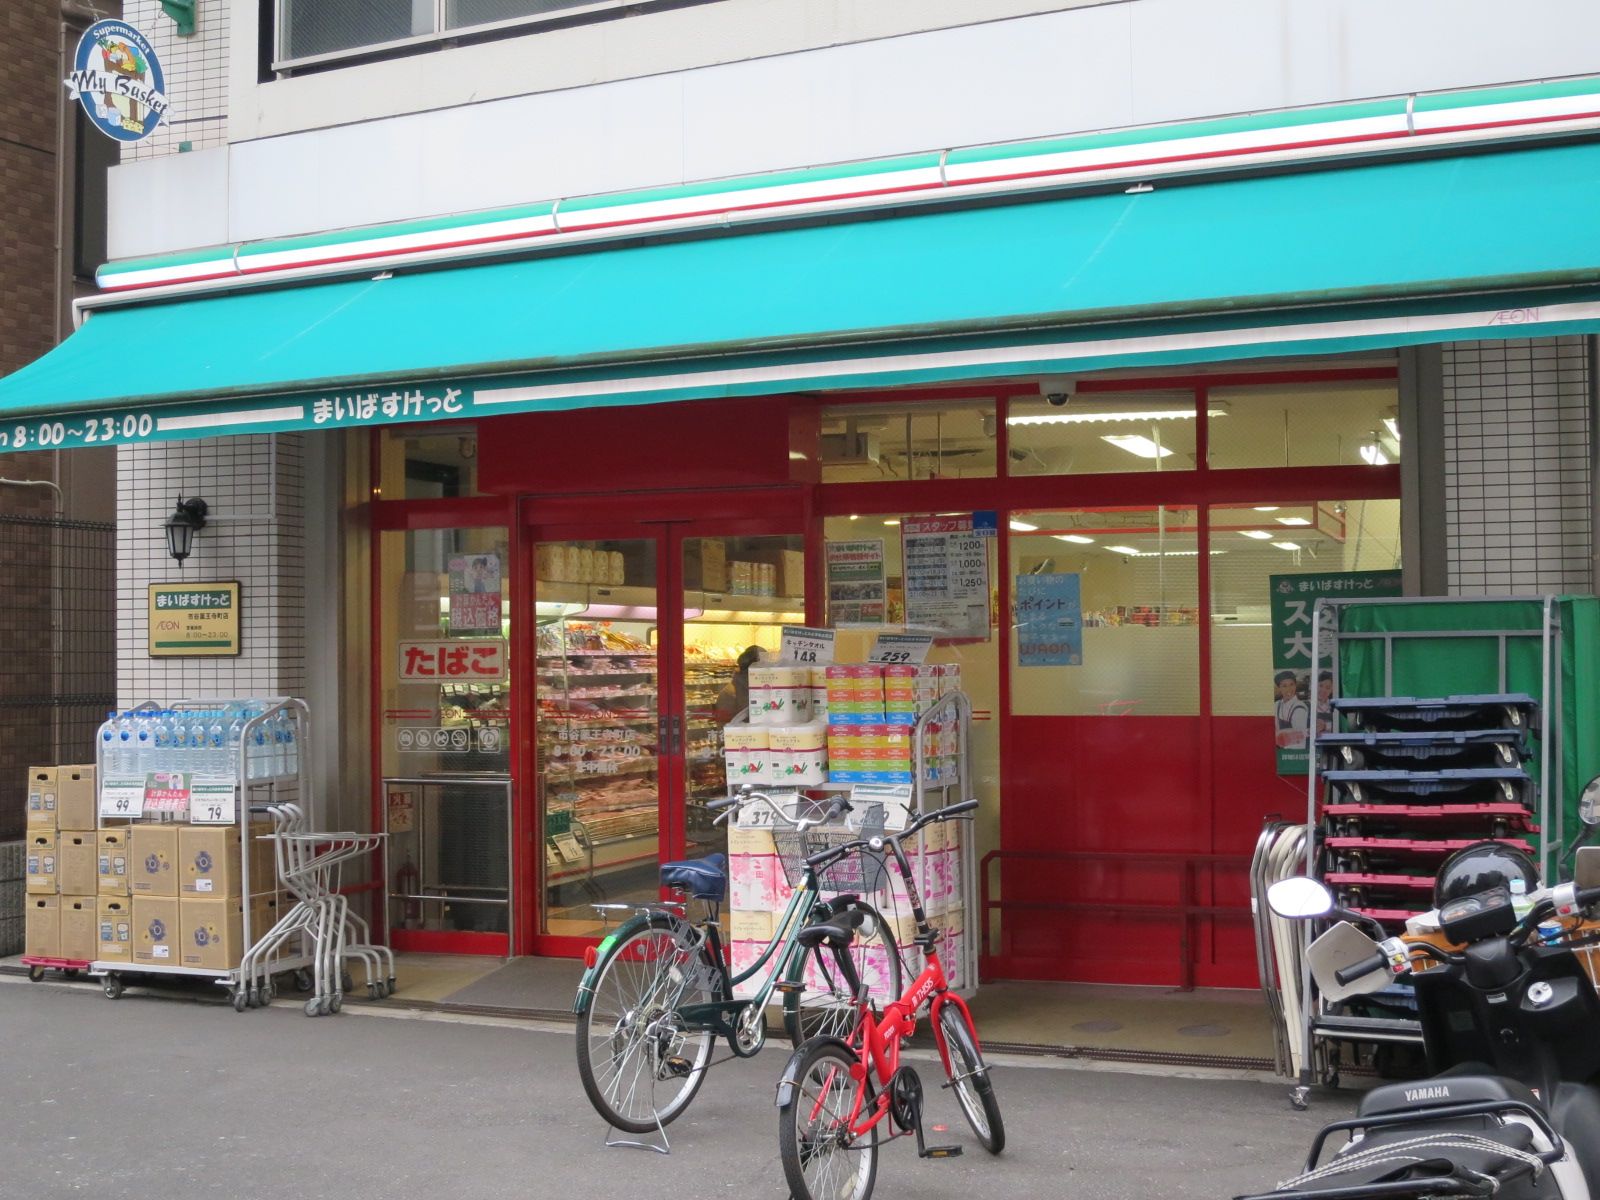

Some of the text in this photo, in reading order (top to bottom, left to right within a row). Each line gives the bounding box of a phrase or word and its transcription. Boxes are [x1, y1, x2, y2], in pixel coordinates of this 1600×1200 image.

[93, 25, 150, 55] Supermarket
[72, 70, 168, 115] My Basket
[313, 388, 463, 424] まいばすけっと
[1298, 579, 1374, 591] まいばすけっと
[156, 594, 230, 607] まいばすけっと
[1020, 597, 1066, 611] ポイント
[405, 646, 499, 675] たばこ
[794, 651, 816, 662] 148
[881, 651, 910, 662] 259
[116, 800, 129, 811] 99
[208, 807, 222, 819] 79
[1405, 1086, 1450, 1102] YAMAHA
